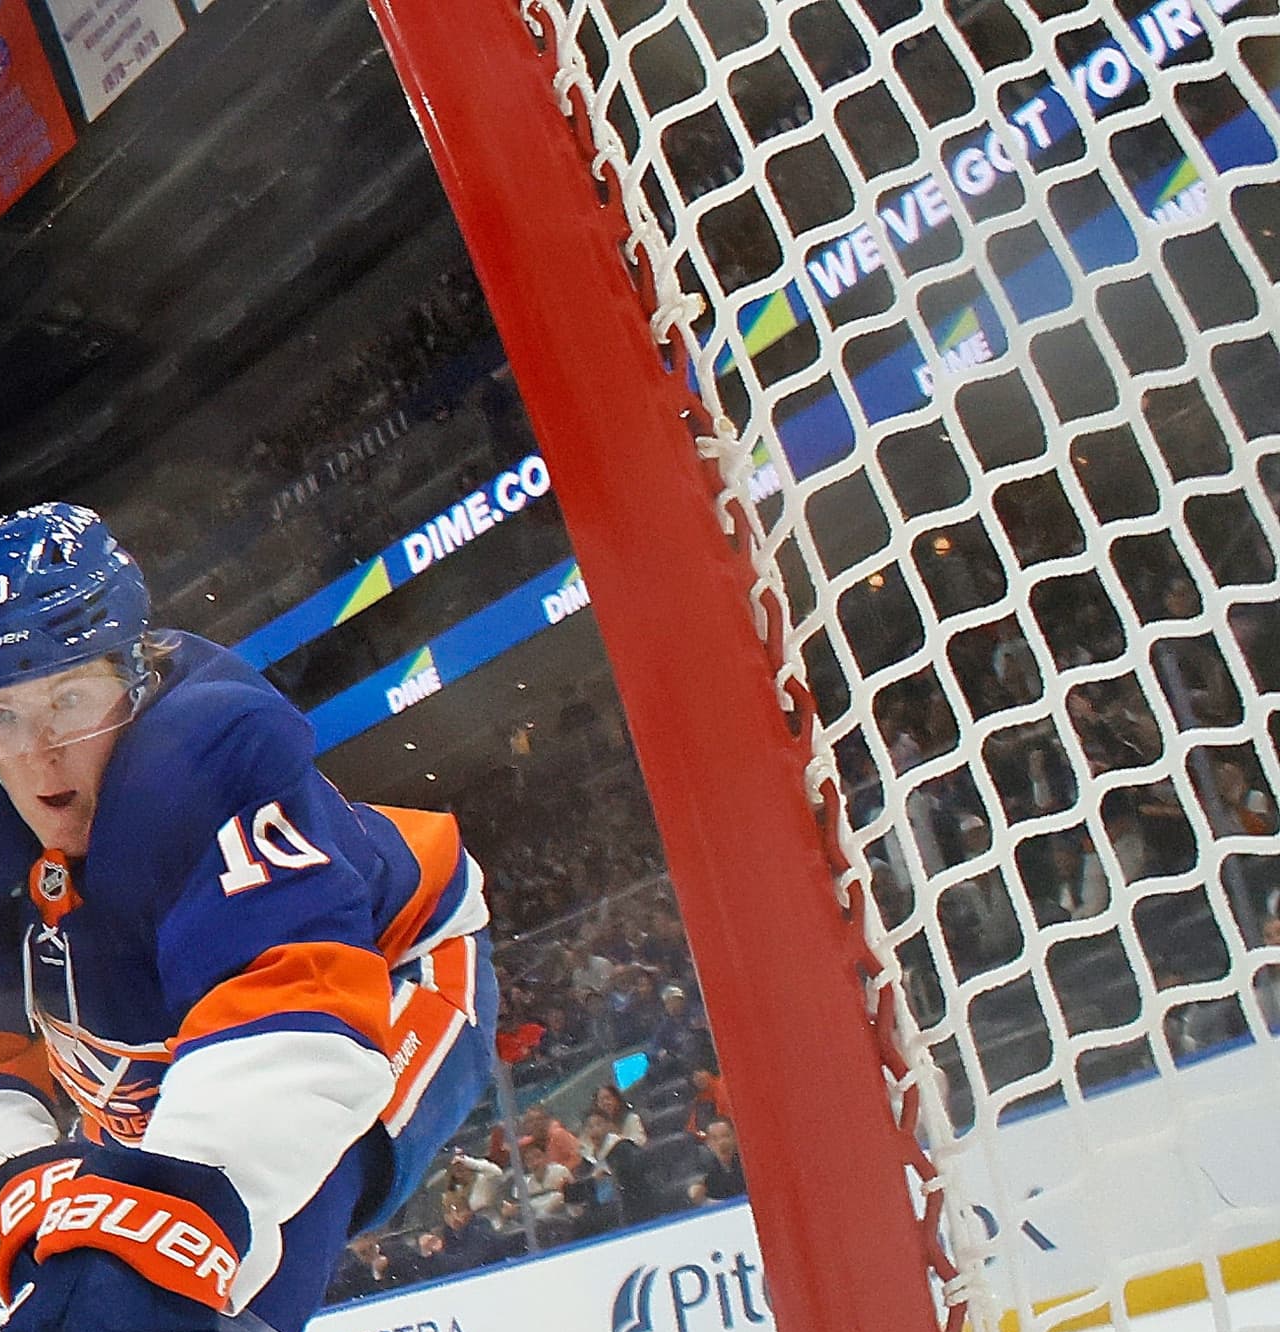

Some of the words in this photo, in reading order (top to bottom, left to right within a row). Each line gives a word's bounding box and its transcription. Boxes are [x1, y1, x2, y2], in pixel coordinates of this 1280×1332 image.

[807, 171, 953, 299] WEVE
[401, 453, 551, 575] DIME.CO
[542, 578, 591, 625] DIM
[386, 666, 441, 714] DIME
[217, 801, 331, 897] 10
[36, 1192, 238, 1298] BAUER
